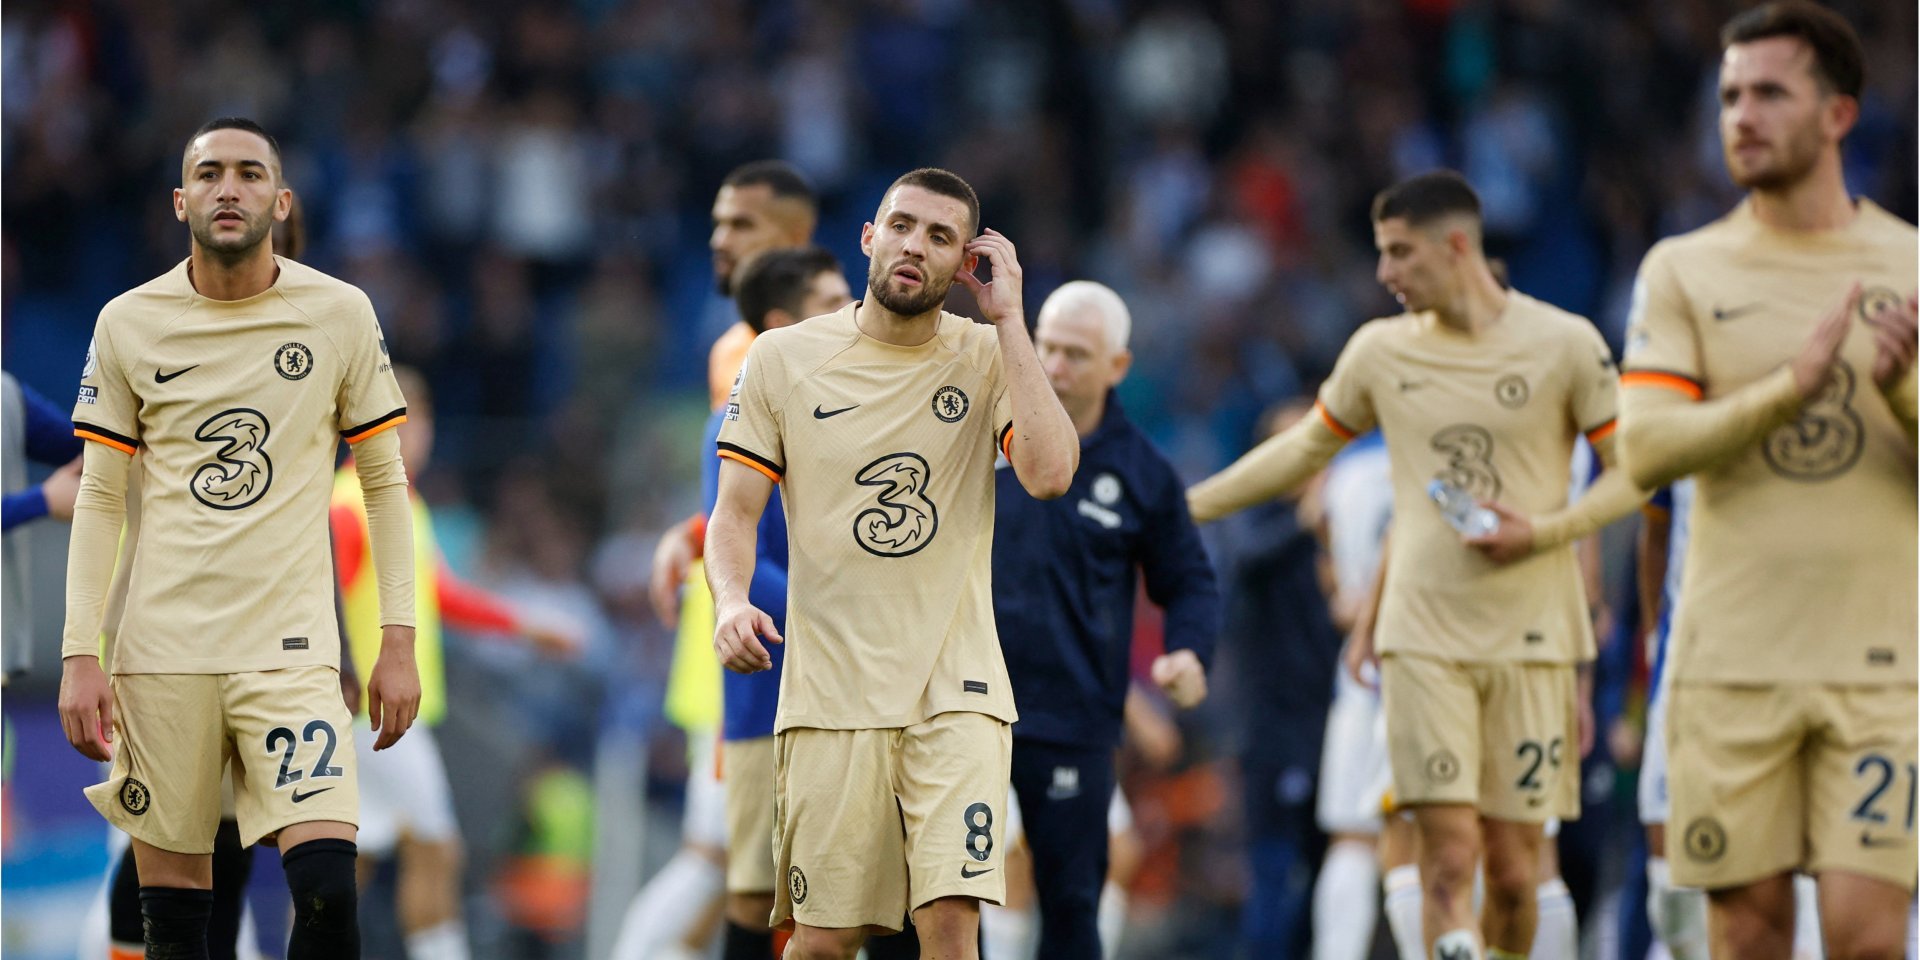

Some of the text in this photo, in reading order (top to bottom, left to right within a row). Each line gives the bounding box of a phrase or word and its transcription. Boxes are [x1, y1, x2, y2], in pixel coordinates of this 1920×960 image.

[280, 343, 307, 352] CHELSEA
[935, 386, 959, 397] CHELSEA
[190, 407, 273, 511] 3
[853, 452, 939, 558] 3
[265, 719, 344, 790] 22
[963, 802, 993, 862] 8
